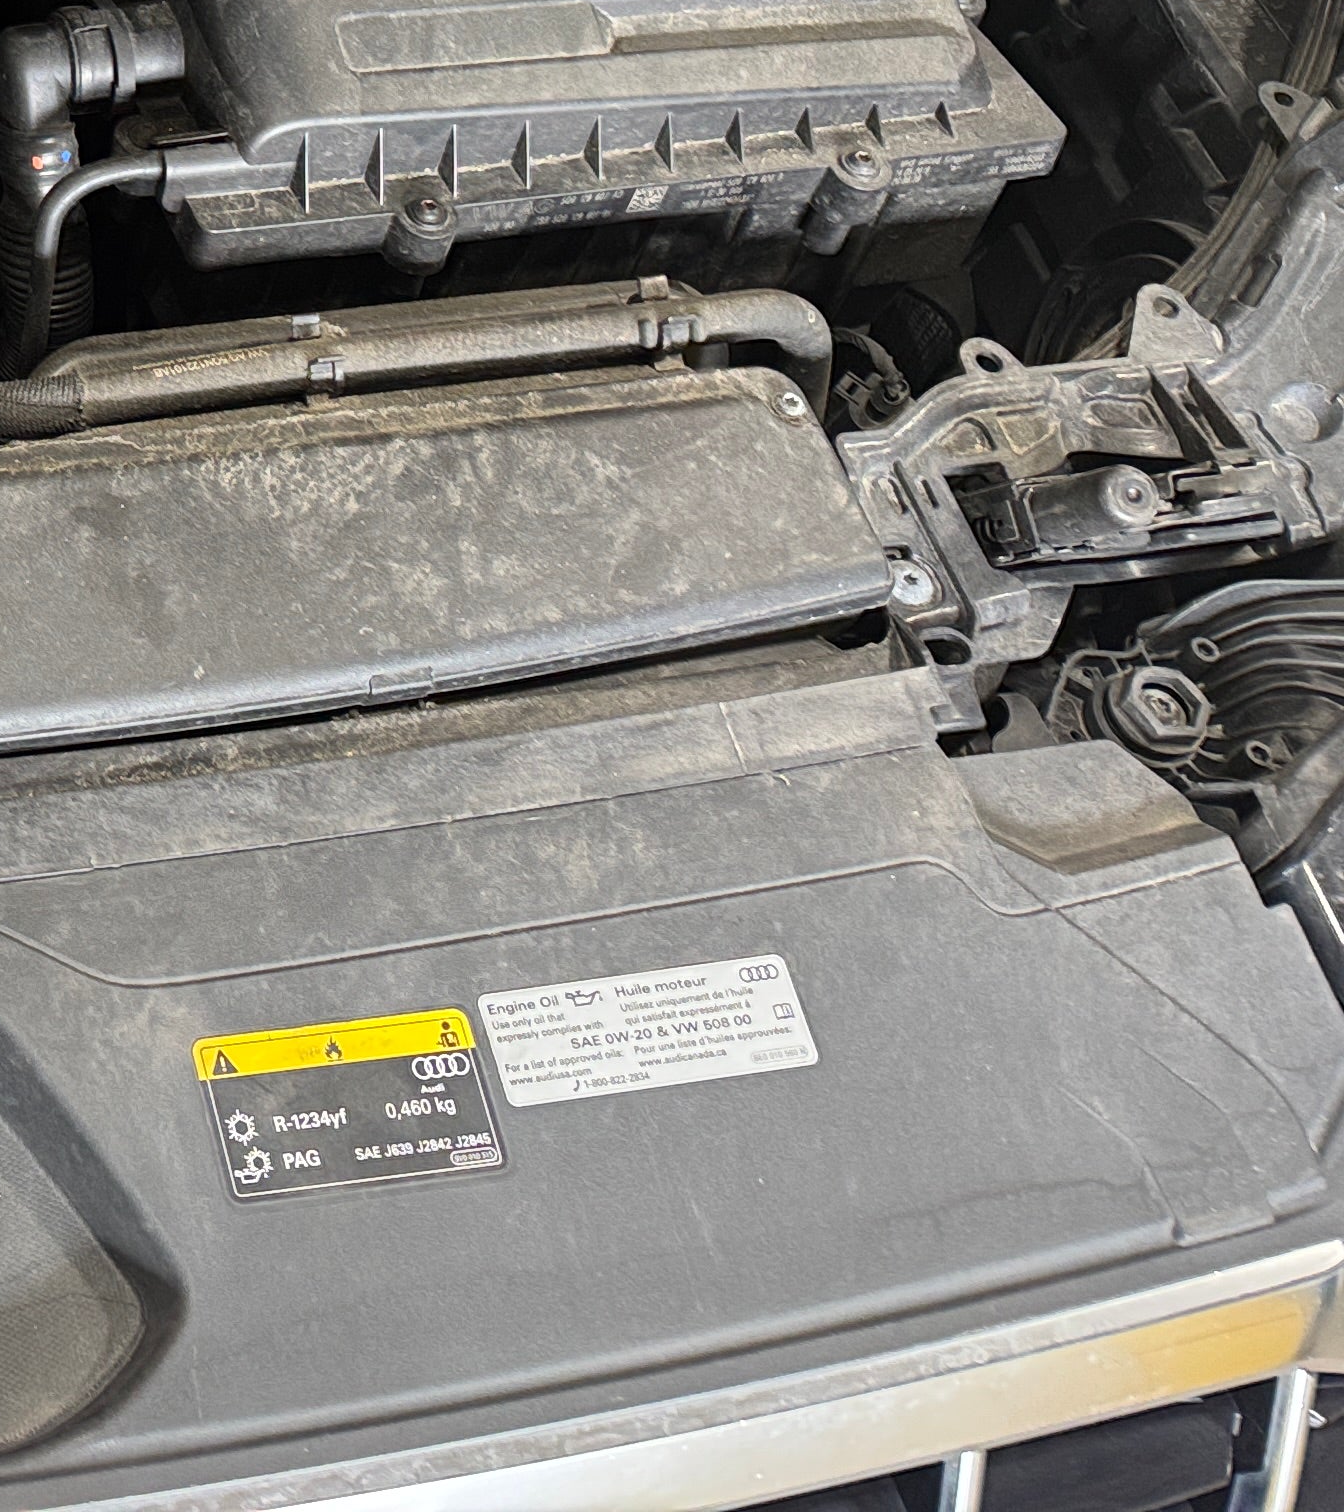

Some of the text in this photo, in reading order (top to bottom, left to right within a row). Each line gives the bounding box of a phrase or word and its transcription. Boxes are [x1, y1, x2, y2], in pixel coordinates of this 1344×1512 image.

[613, 975, 708, 997] Huile moteur
[486, 995, 559, 1017] Engine Oil
[654, 992, 710, 1008] uniquement
[710, 990, 724, 999] de
[491, 1011, 565, 1030] Use only oil that
[623, 1015, 637, 1025] qui
[640, 1009, 677, 1022] satisfait
[495, 1020, 604, 1044] expressly complies with
[569, 1013, 752, 1049] SAE 0W-20 & VW 508 00
[633, 1043, 656, 1055] Pour
[657, 1041, 676, 1051] une
[504, 1062, 521, 1073] For
[529, 1058, 545, 1069] list
[546, 1057, 557, 1067] of
[558, 1051, 604, 1067] approved
[508, 1066, 592, 1086] www.audiusa.com
[419, 1081, 445, 1094] Audi
[383, 1094, 457, 1123] 0,460 kg
[271, 1106, 350, 1137] R-1234yf
[353, 1129, 491, 1162] SAE J639 J2842 J2845
[281, 1148, 322, 1171] PAG
